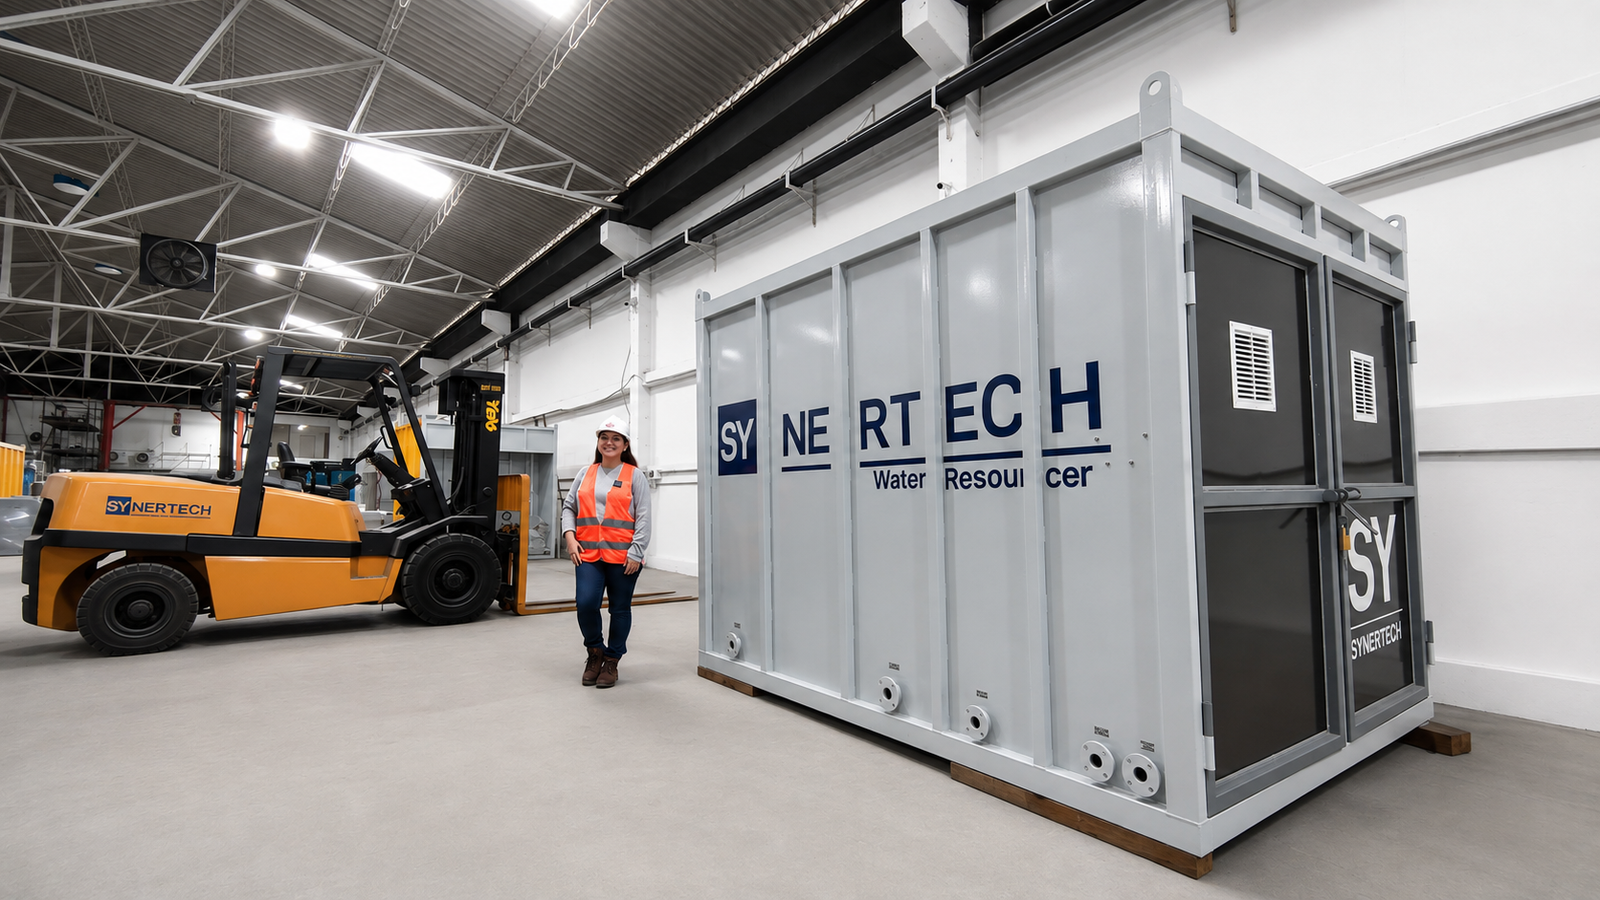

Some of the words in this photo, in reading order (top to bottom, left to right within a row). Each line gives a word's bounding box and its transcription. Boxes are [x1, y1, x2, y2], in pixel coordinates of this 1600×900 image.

[873, 469, 926, 490] Water
[107, 500, 212, 516] SYNERTECH
[1348, 514, 1397, 612] SY
[1351, 621, 1402, 660] SYNERTECH
